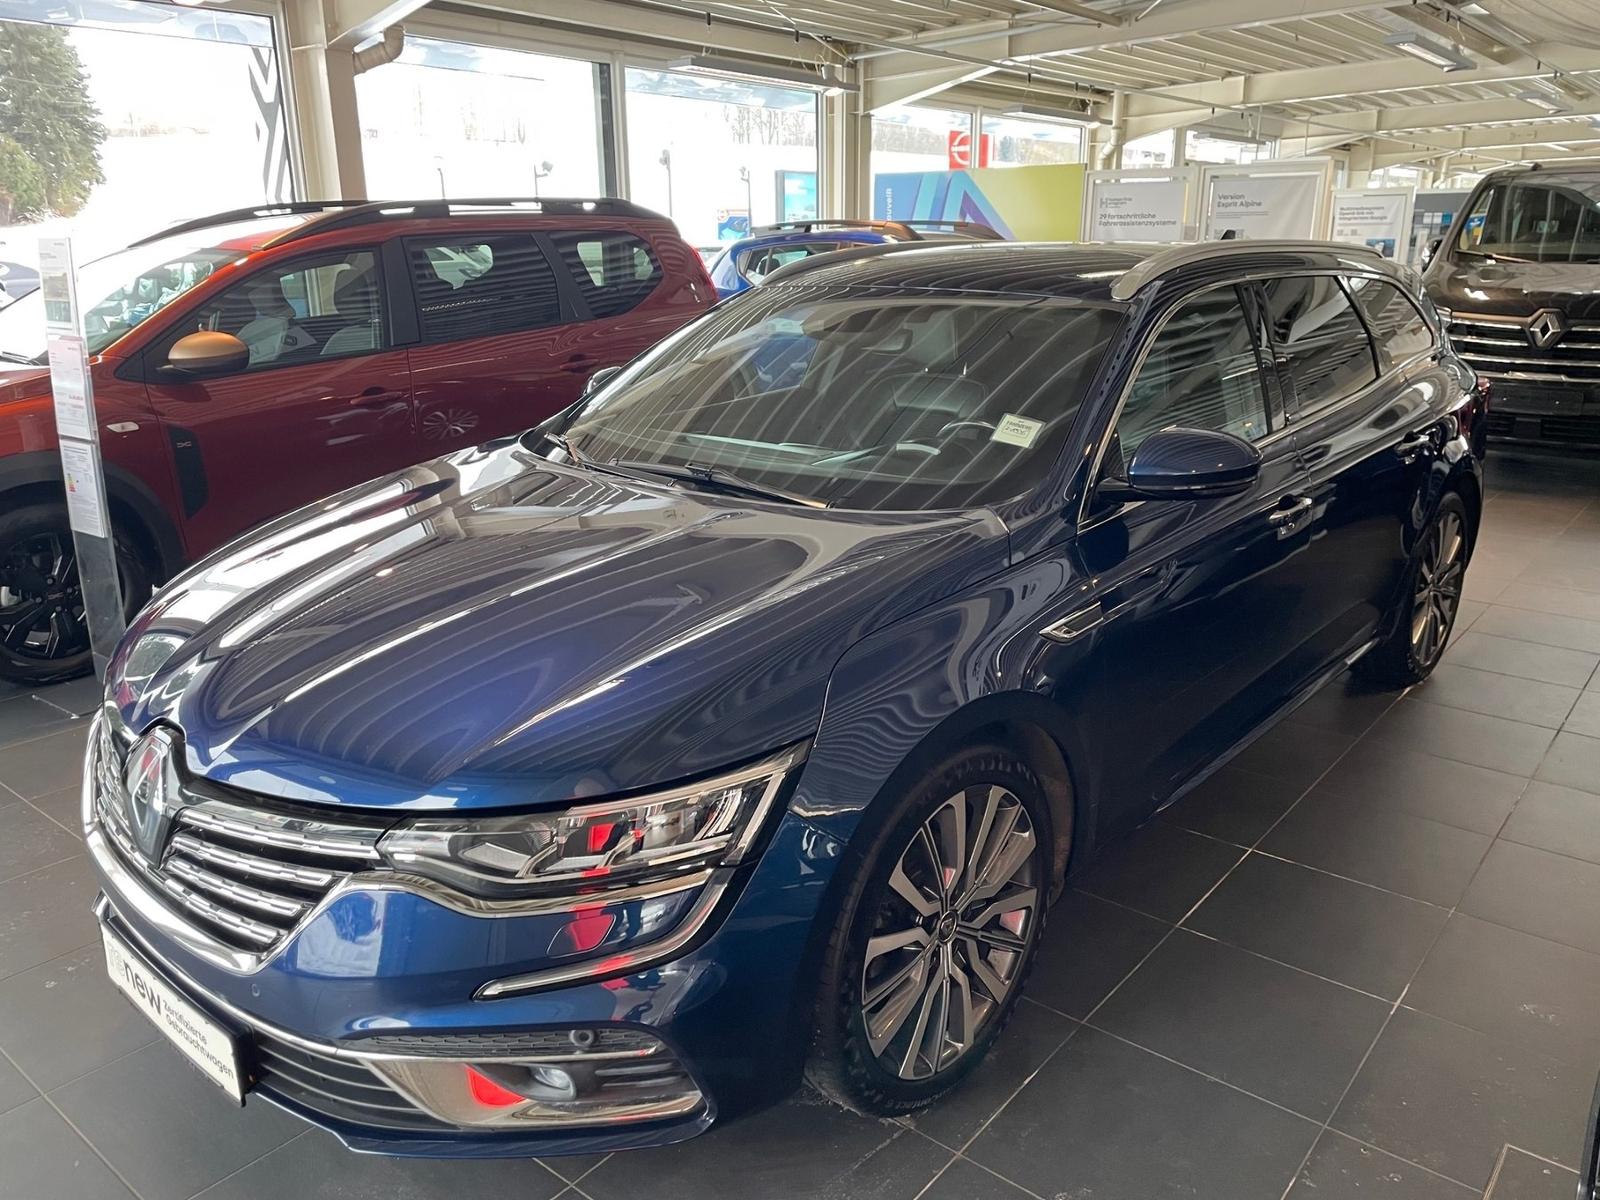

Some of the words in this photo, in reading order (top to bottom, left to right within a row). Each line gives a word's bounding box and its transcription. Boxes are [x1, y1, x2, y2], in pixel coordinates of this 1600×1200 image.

[1239, 200, 1263, 208] Alpine
[164, 1000, 207, 1045] Zertifizierte
[166, 1014, 234, 1079] Gebrauchtwagen
